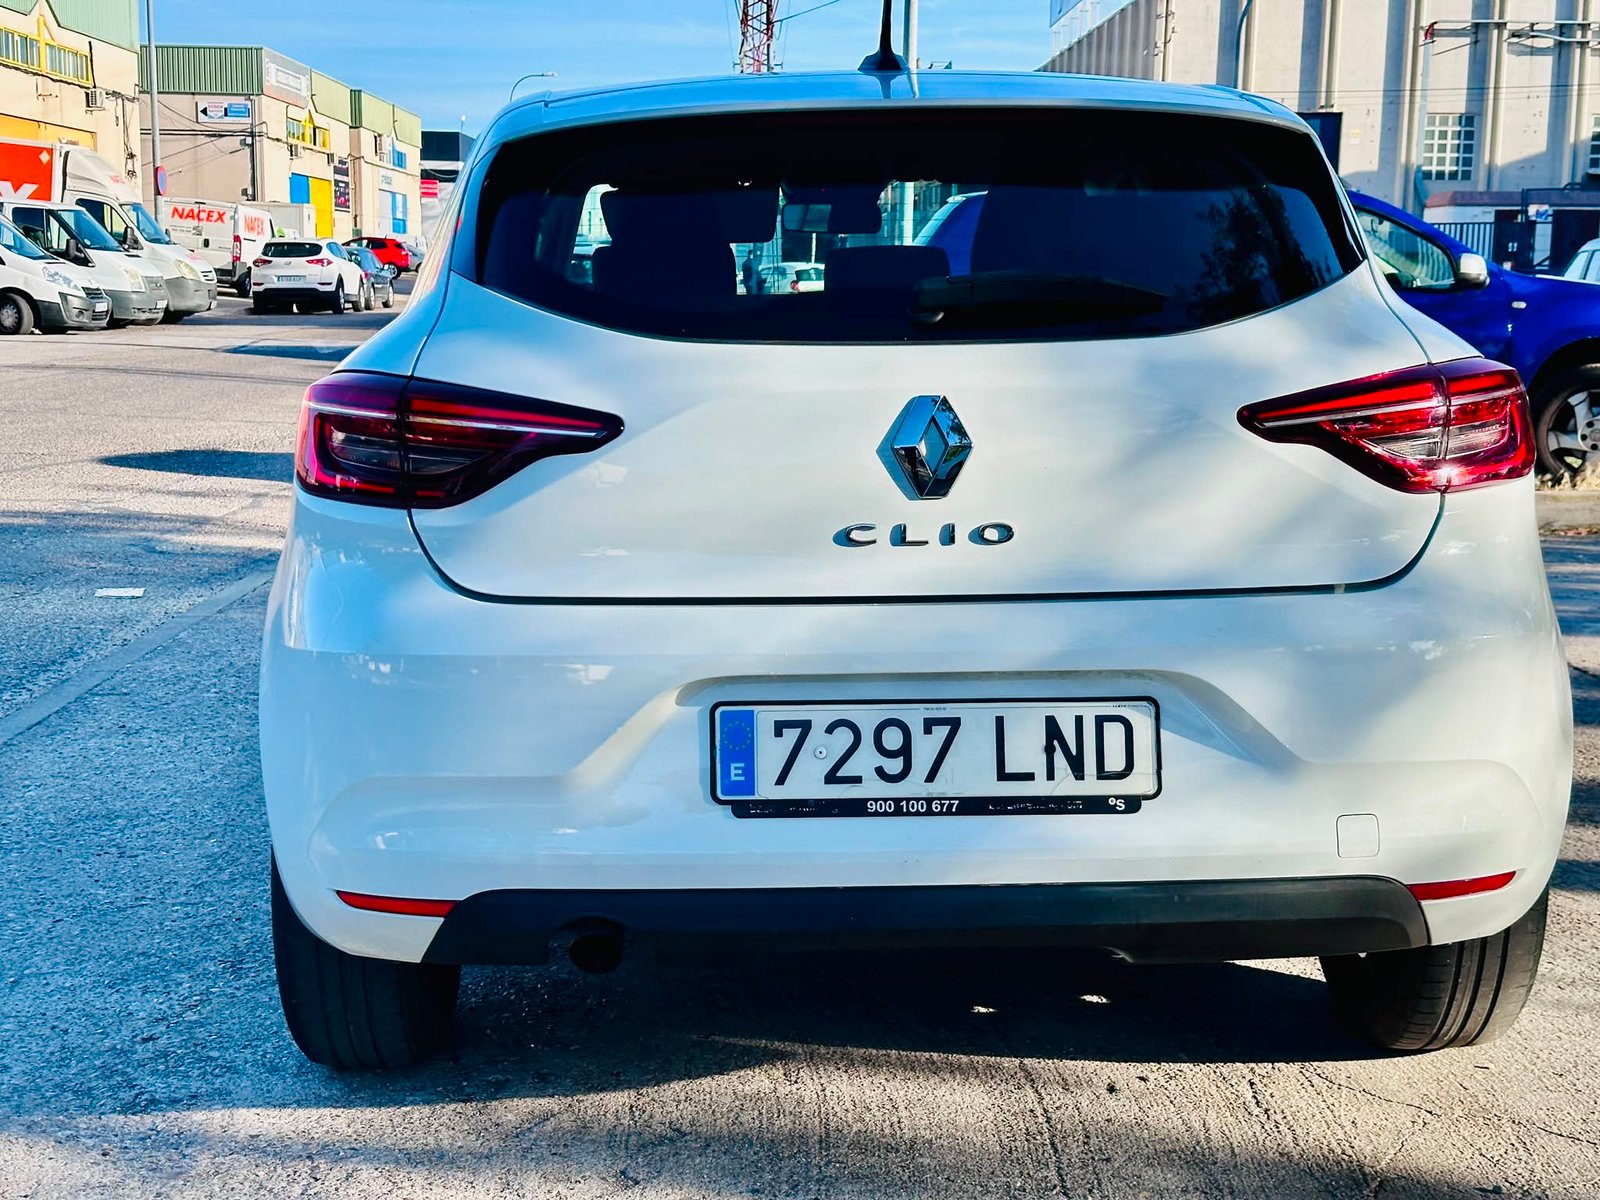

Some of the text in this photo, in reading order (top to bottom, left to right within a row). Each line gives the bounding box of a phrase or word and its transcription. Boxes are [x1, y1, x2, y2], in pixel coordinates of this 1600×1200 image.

[171, 206, 226, 224] NACEX
[833, 522, 1015, 547] CLIO
[773, 714, 1135, 786] 7297 LND
[730, 763, 745, 781] E
[866, 799, 960, 813] 900 100 677
